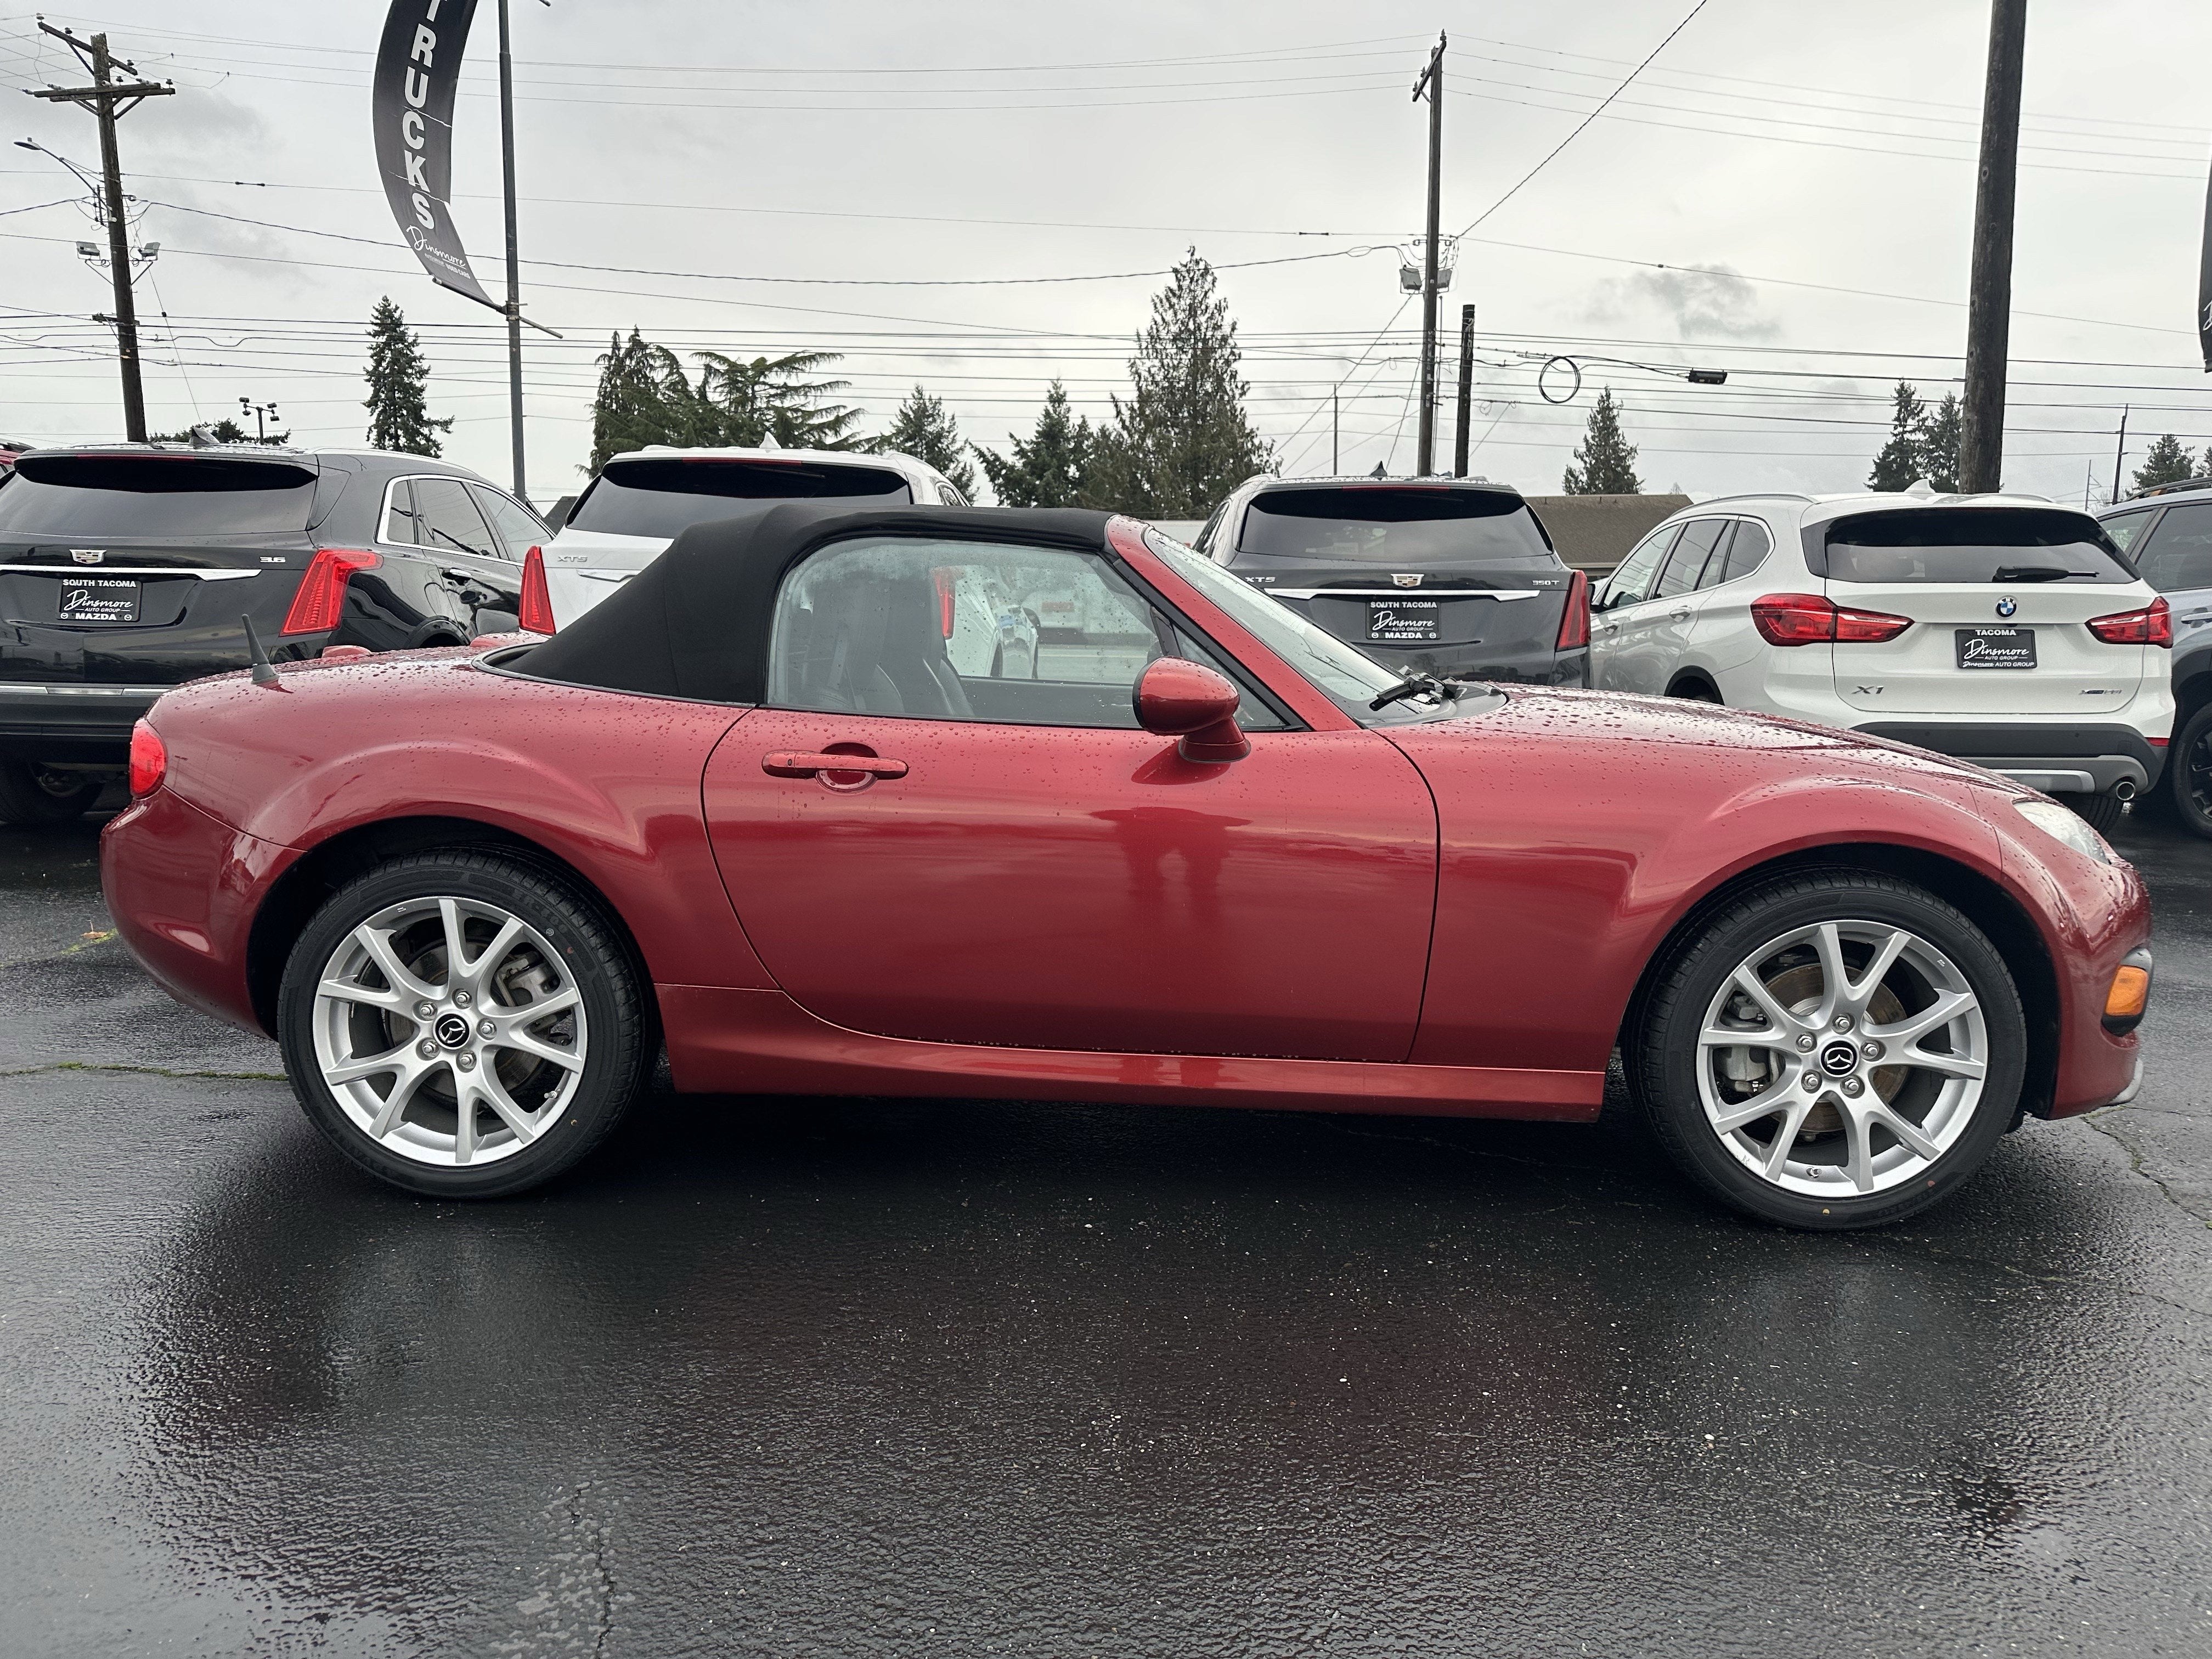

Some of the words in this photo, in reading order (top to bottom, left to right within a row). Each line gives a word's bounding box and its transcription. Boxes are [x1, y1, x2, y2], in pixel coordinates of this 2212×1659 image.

[406, 225, 466, 267] Dinsmore
[64, 589, 133, 611] Dinsmore
[1372, 610, 1435, 630] Dinsmore
[1964, 638, 2030, 659] Dinsmore
[1852, 685, 1884, 694] X1
